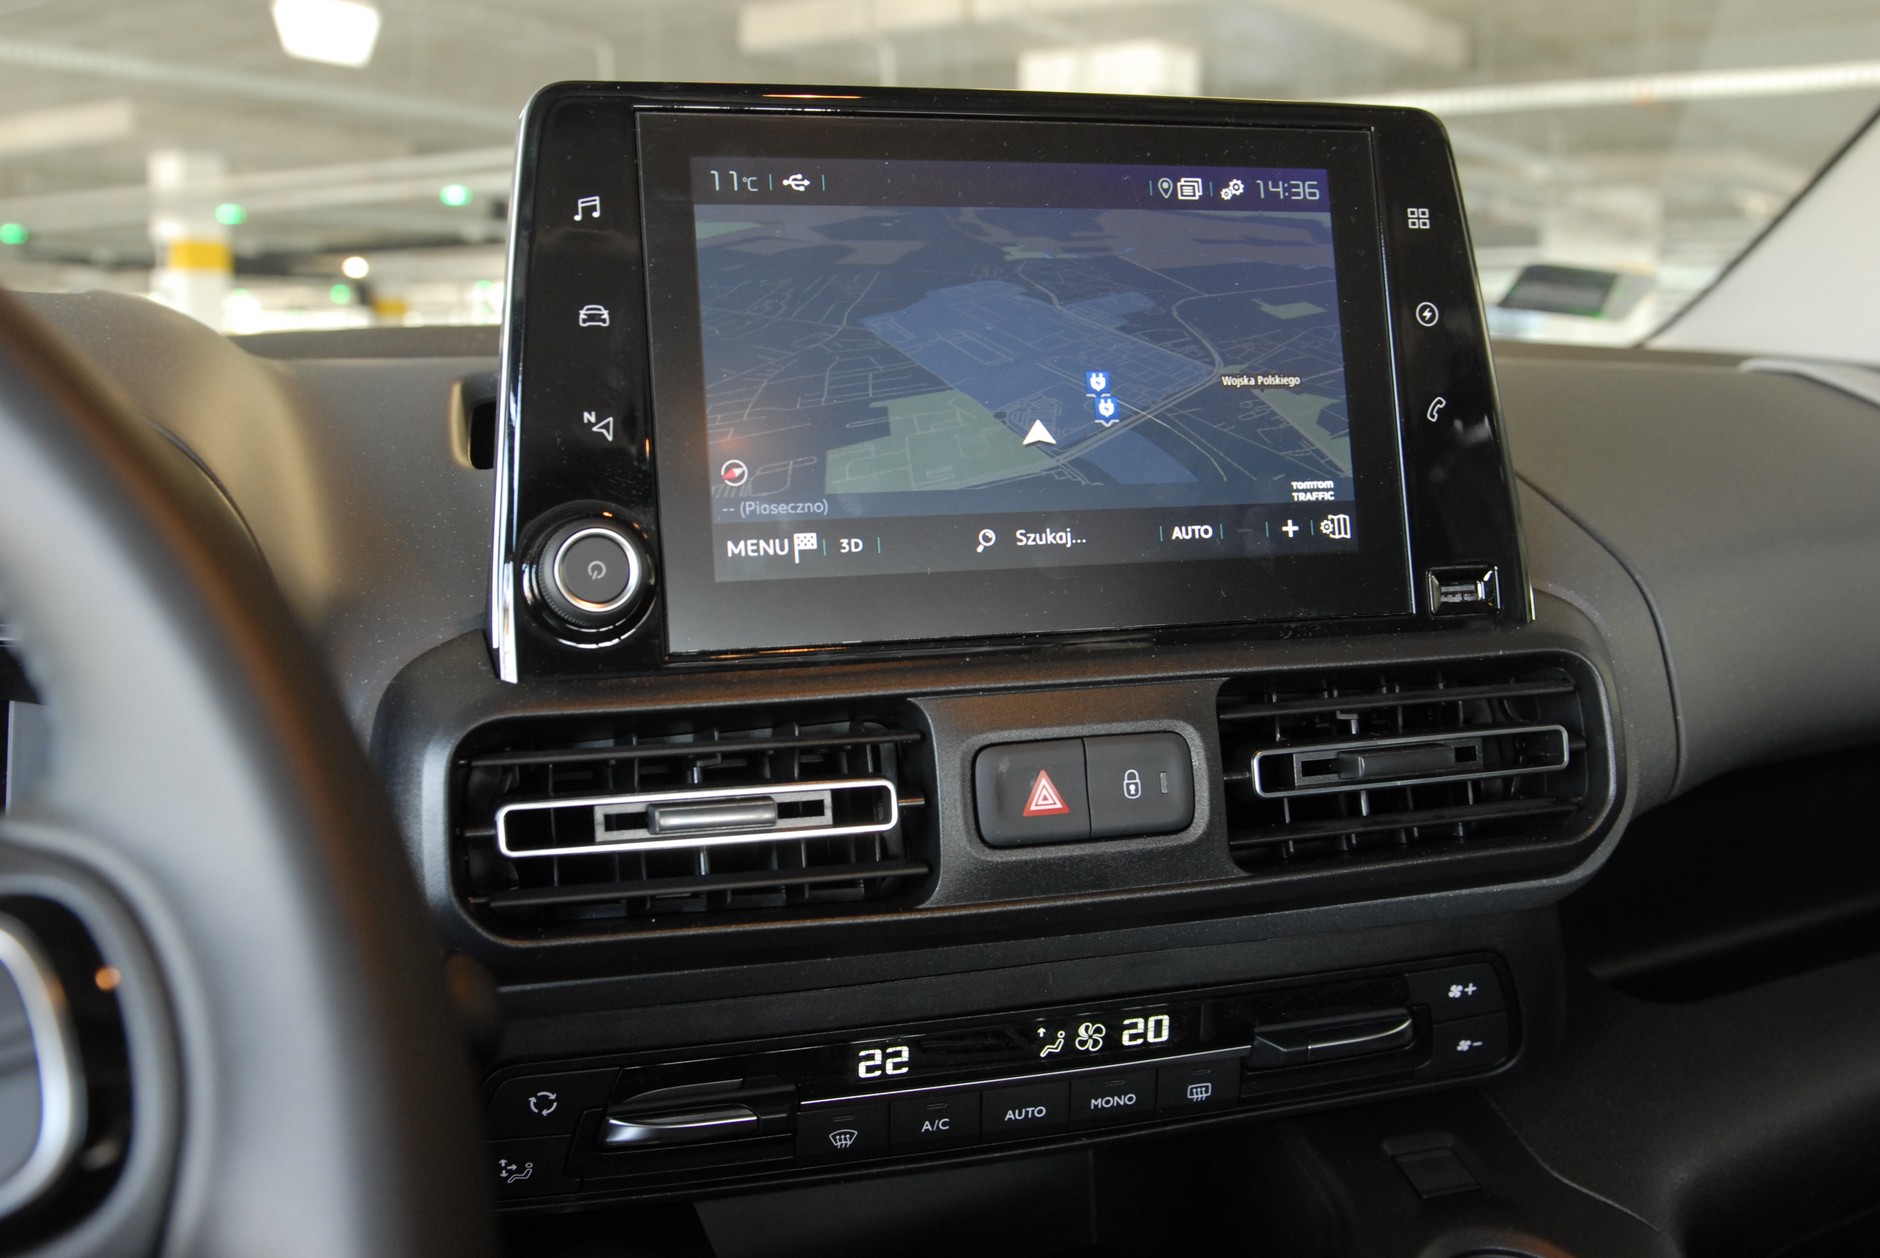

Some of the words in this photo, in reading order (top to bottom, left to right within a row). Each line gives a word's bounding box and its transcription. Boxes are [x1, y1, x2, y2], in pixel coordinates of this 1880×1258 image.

[1256, 179, 1320, 200] 14:36
[1221, 375, 1255, 388] Wojska
[1257, 375, 1301, 387] Polskiego
[583, 411, 596, 424] N
[1292, 491, 1335, 501] TRAFFIC
[740, 498, 829, 519] (Piaseczno)
[1016, 527, 1087, 548] Szukaj...
[1171, 525, 1213, 541] AUTO
[726, 537, 790, 558] MENU
[839, 538, 864, 553] 3D
[1121, 1014, 1170, 1047] 20
[858, 1045, 910, 1079] 22
[1090, 1094, 1137, 1110] MONO
[1004, 1106, 1047, 1122] AUTO
[921, 1117, 950, 1133] A/C
